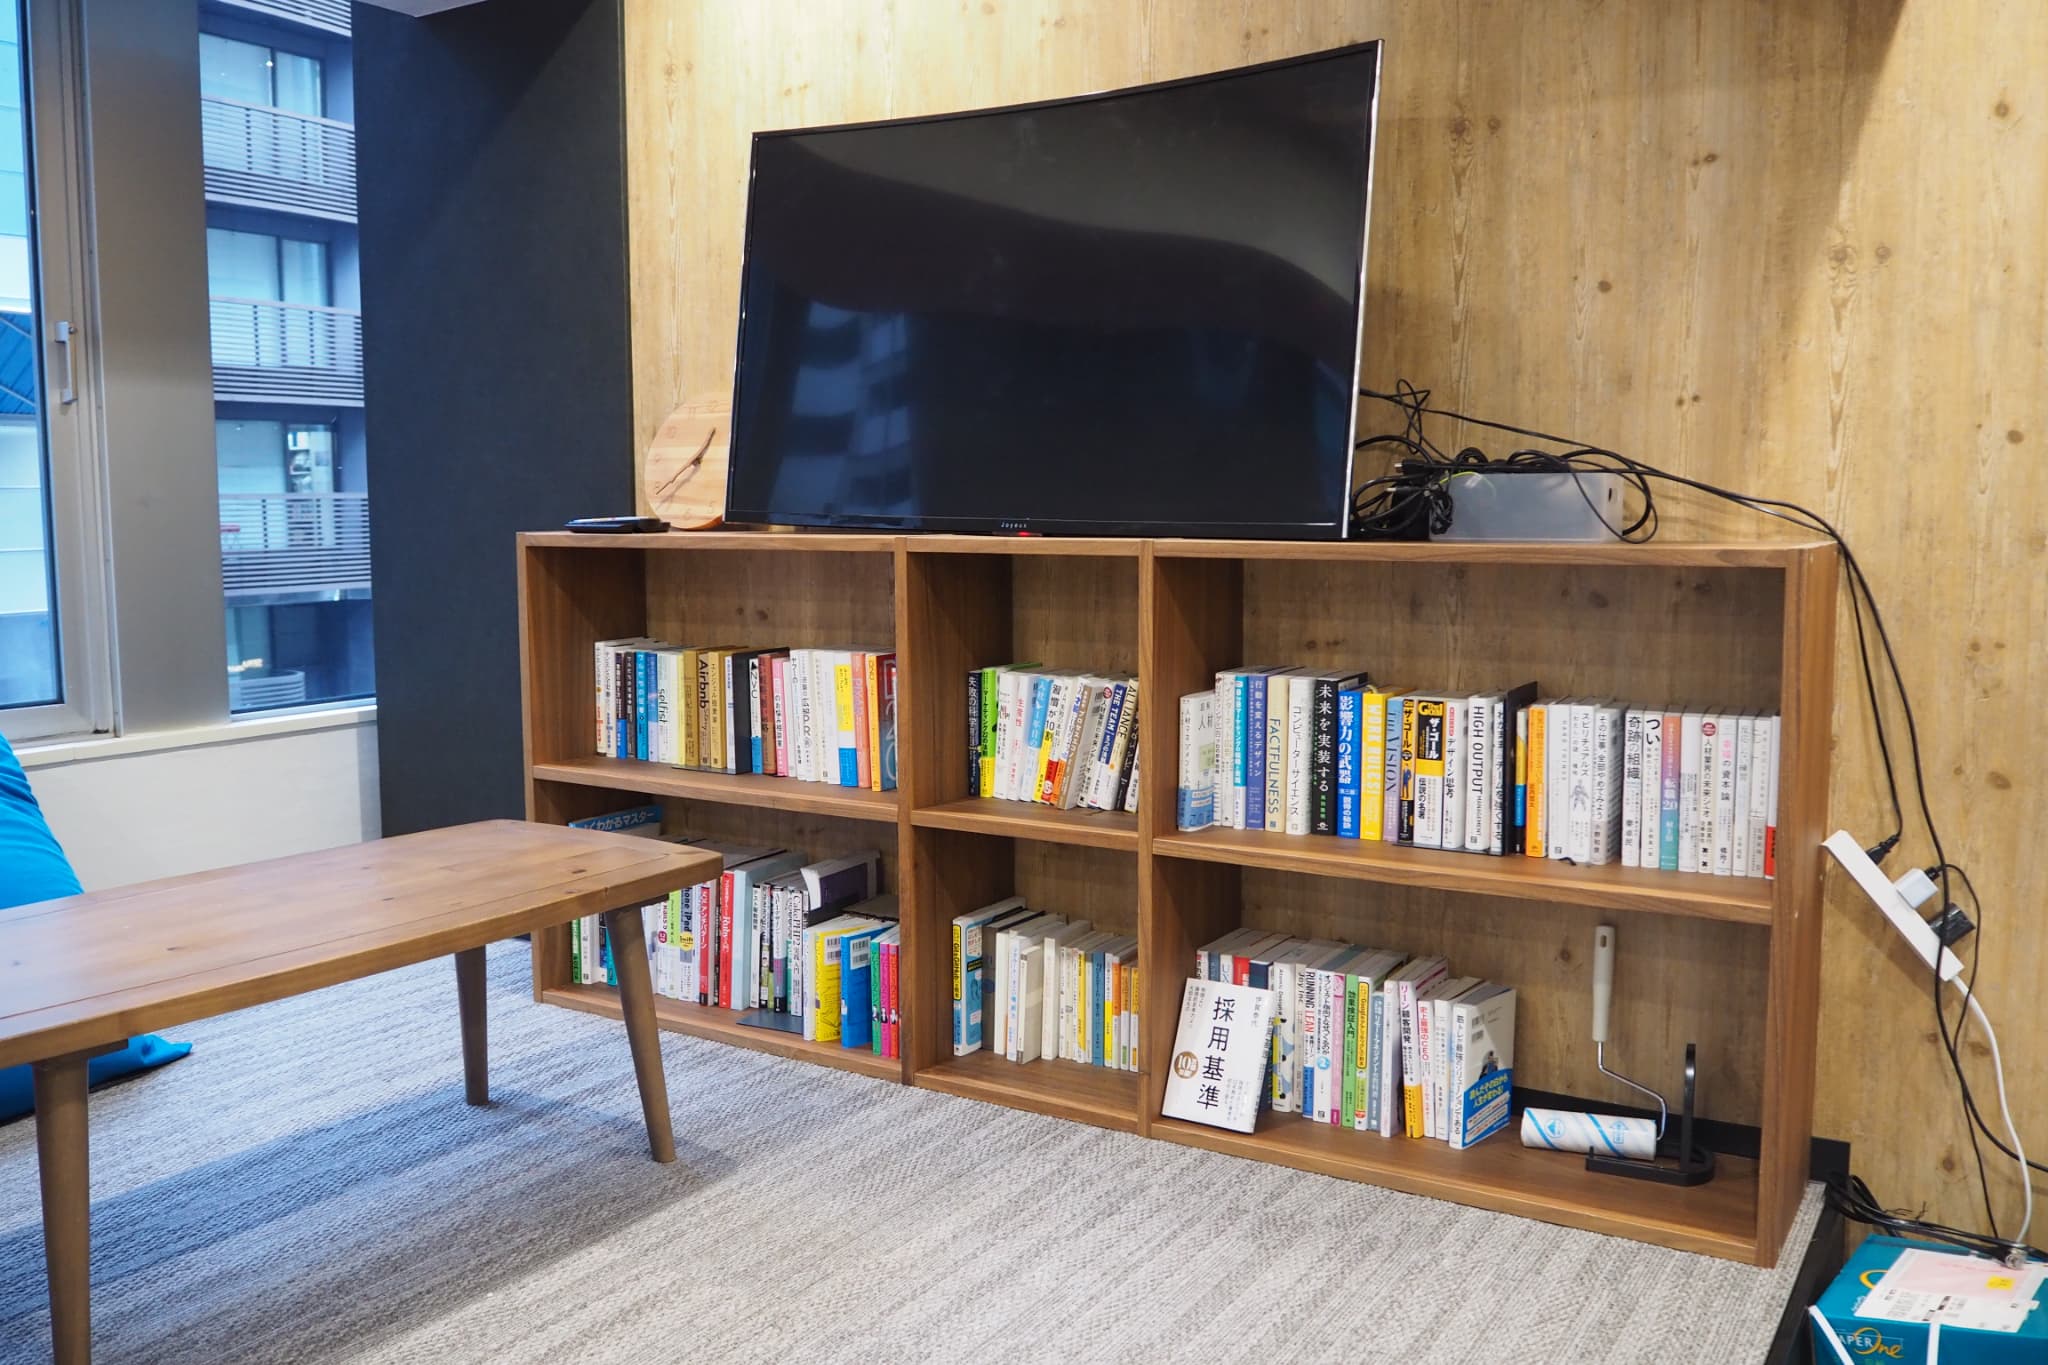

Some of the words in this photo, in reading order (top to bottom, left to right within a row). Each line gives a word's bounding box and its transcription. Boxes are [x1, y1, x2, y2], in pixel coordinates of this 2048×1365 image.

[698, 658, 710, 709] Airbnb
[1113, 688, 1123, 707] THE
[1044, 683, 1062, 742] 習慣が10割
[1107, 707, 1118, 732] TEAM
[1119, 685, 1137, 740] ALLIANCE
[1253, 680, 1264, 777] 行動を変えるデザイン
[1317, 684, 1333, 792] 未来を実装する
[1367, 704, 1382, 742] WORK
[1402, 709, 1413, 749] ザ・ゴール
[1428, 717, 1441, 759] ザ・ゴール
[1472, 706, 1485, 738] HIGH
[1645, 718, 1661, 745] つい
[1268, 718, 1281, 814] FACTFULNESS
[1290, 706, 1302, 816] コンピューターサイエンス
[1339, 695, 1353, 784] 影響力の武器
[1385, 736, 1400, 793] VISION
[1579, 712, 1590, 777] スピリチュアルズ
[1446, 738, 1456, 798] デザイン思考
[1471, 742, 1484, 795] OUTPUT
[1595, 715, 1607, 820] その仕事、全部やめてみよう
[585, 811, 656, 832] くわかるマスター
[684, 912, 693, 933] iPad
[723, 916, 731, 938] Ruby
[793, 894, 801, 946] CakePHP2
[1304, 971, 1315, 1009] RUNNING
[1321, 975, 1332, 1056] オブジェクト指向でなぜつくるのか
[1401, 984, 1412, 1044] リーン顧客開発
[1304, 1009, 1314, 1033] LEAN
[1419, 1006, 1430, 1061] 史上最強のCEO
[1196, 995, 1236, 1111] 採用基準
[1454, 1014, 1465, 1136] 筋トレが最強のソリューションである
[1837, 1334, 1872, 1348] APER
[1853, 1326, 1905, 1359] One
